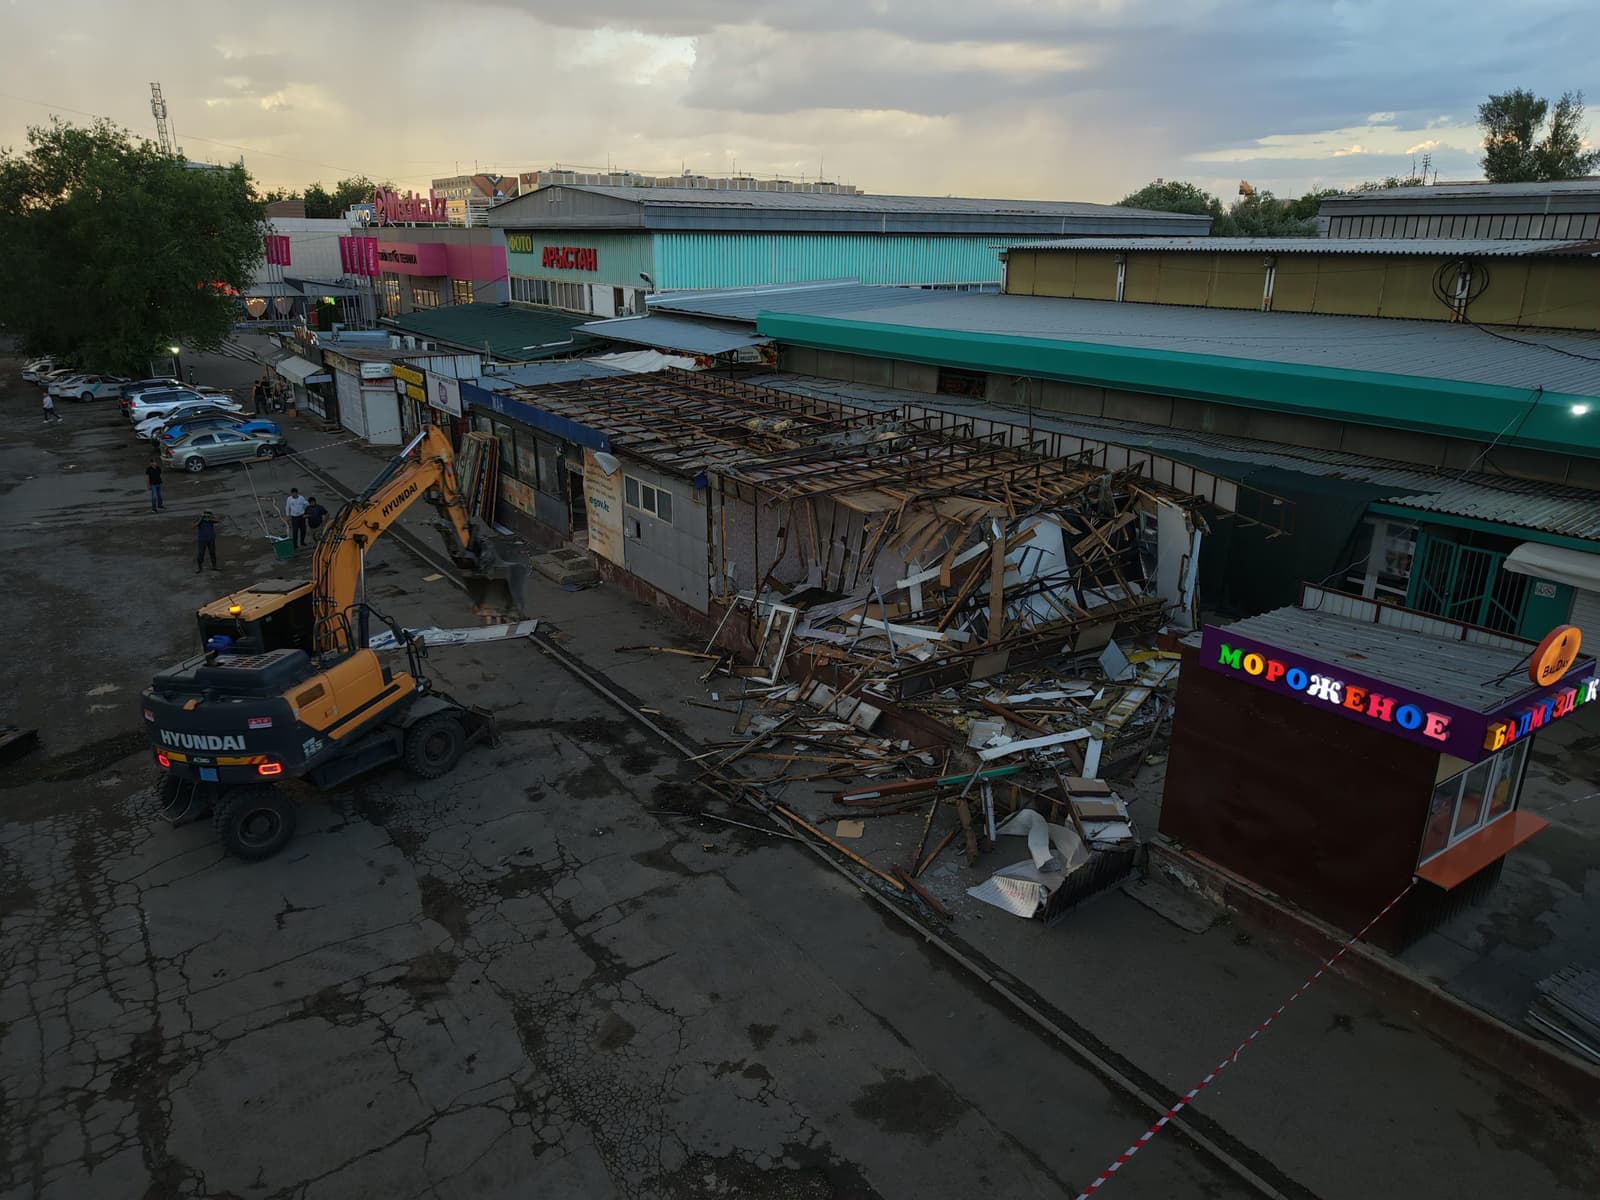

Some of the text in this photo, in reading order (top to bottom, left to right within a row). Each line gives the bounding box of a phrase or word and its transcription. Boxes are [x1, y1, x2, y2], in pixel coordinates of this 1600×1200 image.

[510, 235, 532, 251] ФОТО
[542, 246, 597, 272] АРЫСТАН
[382, 482, 418, 517] HYUNDAI
[1218, 643, 1452, 742] МОРОЖЕНОЕ
[160, 729, 247, 751] HYUNDAI
